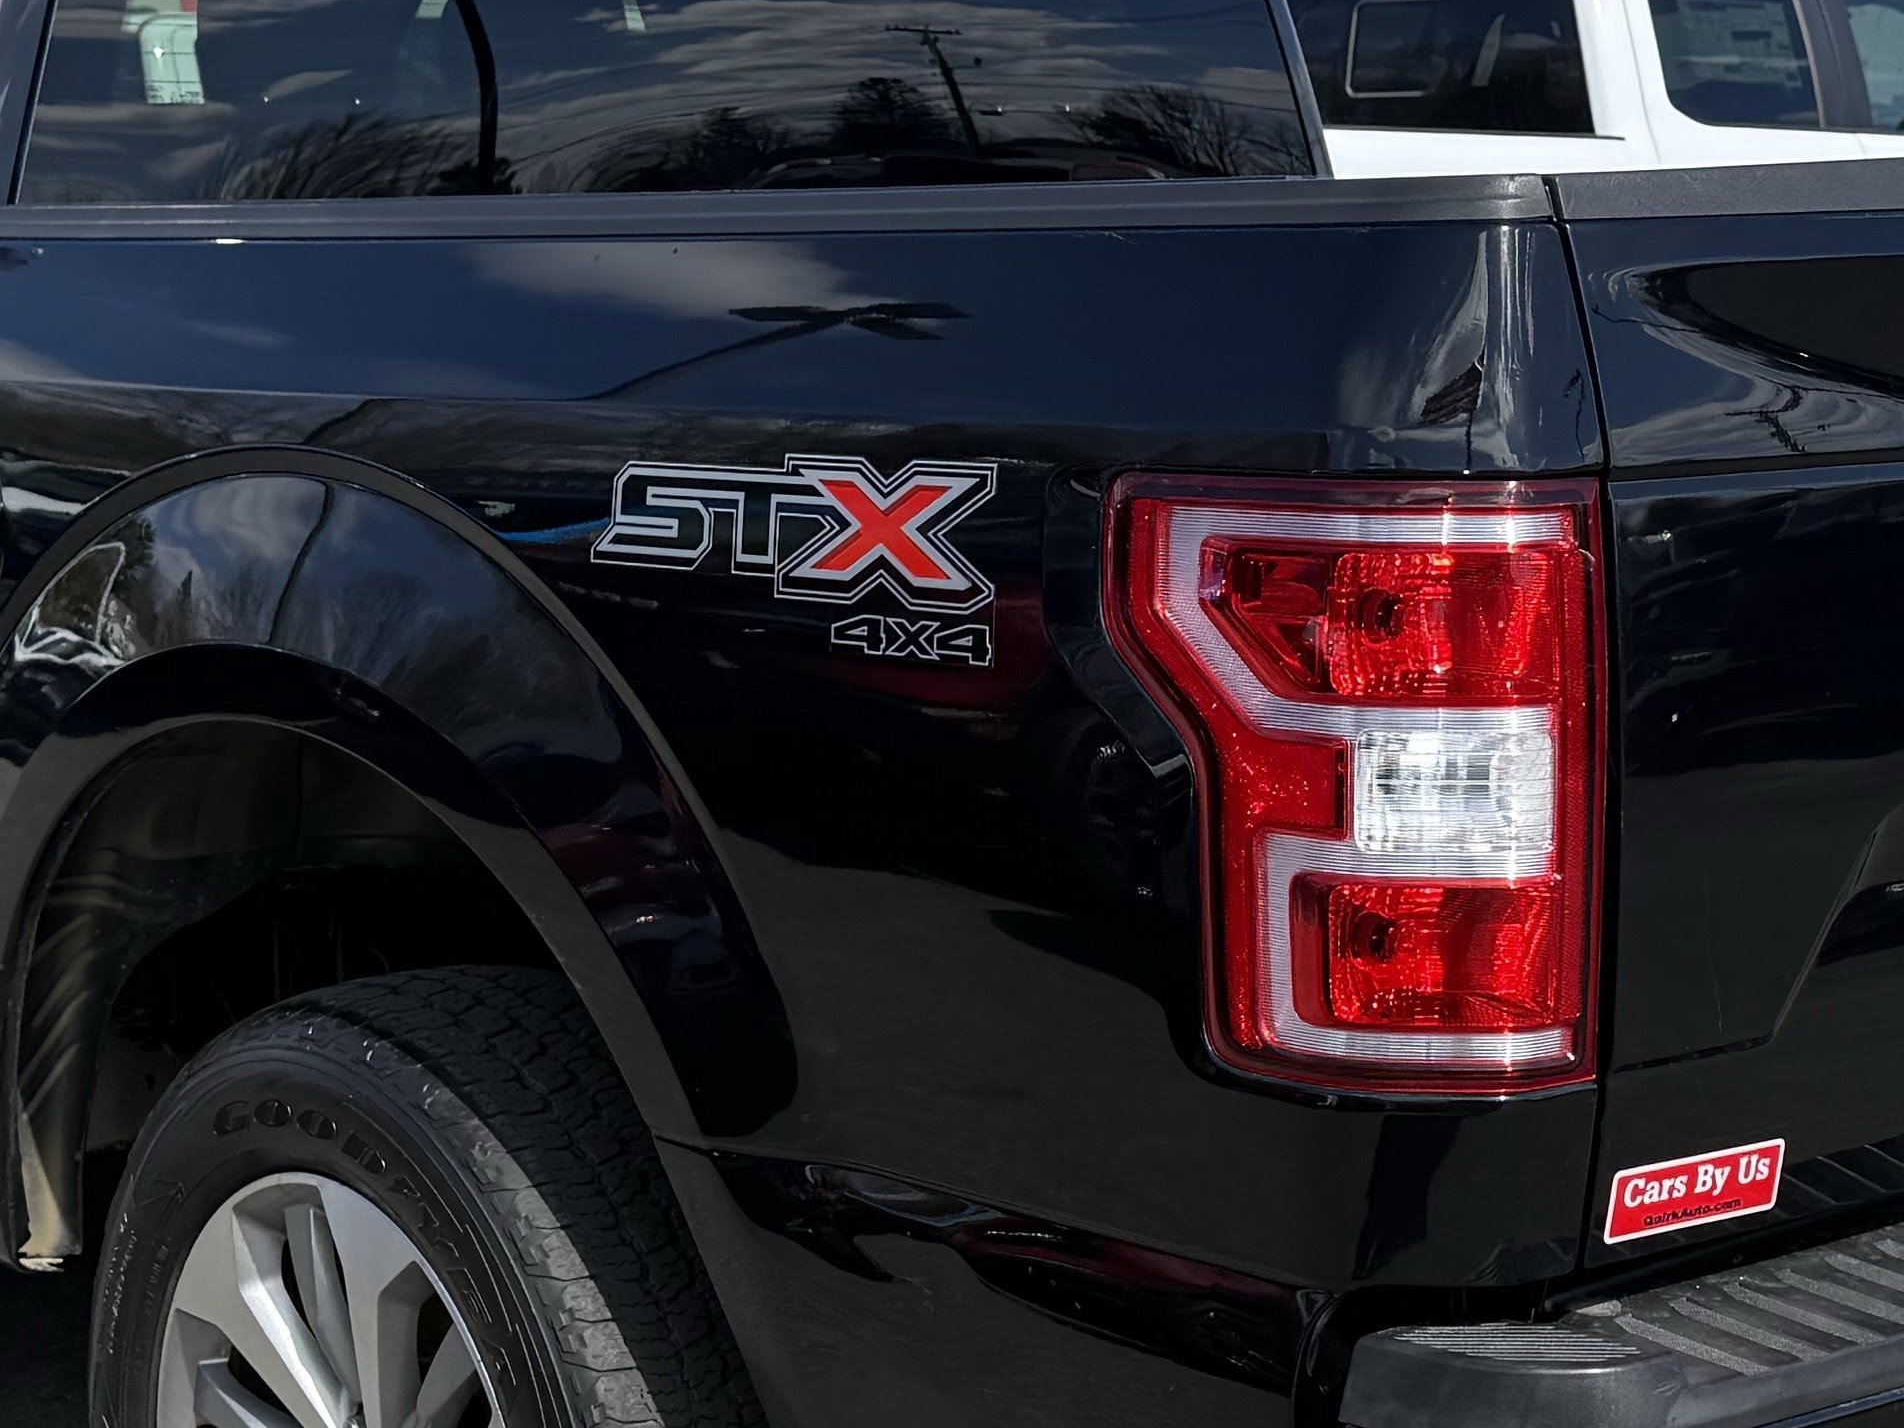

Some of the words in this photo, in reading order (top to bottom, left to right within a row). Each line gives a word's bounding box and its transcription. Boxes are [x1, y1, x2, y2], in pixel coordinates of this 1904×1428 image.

[591, 453, 998, 614] STX
[1623, 1172, 1688, 1208] Cars
[1693, 1163, 1732, 1197] By
[1737, 1153, 1772, 1185] Us
